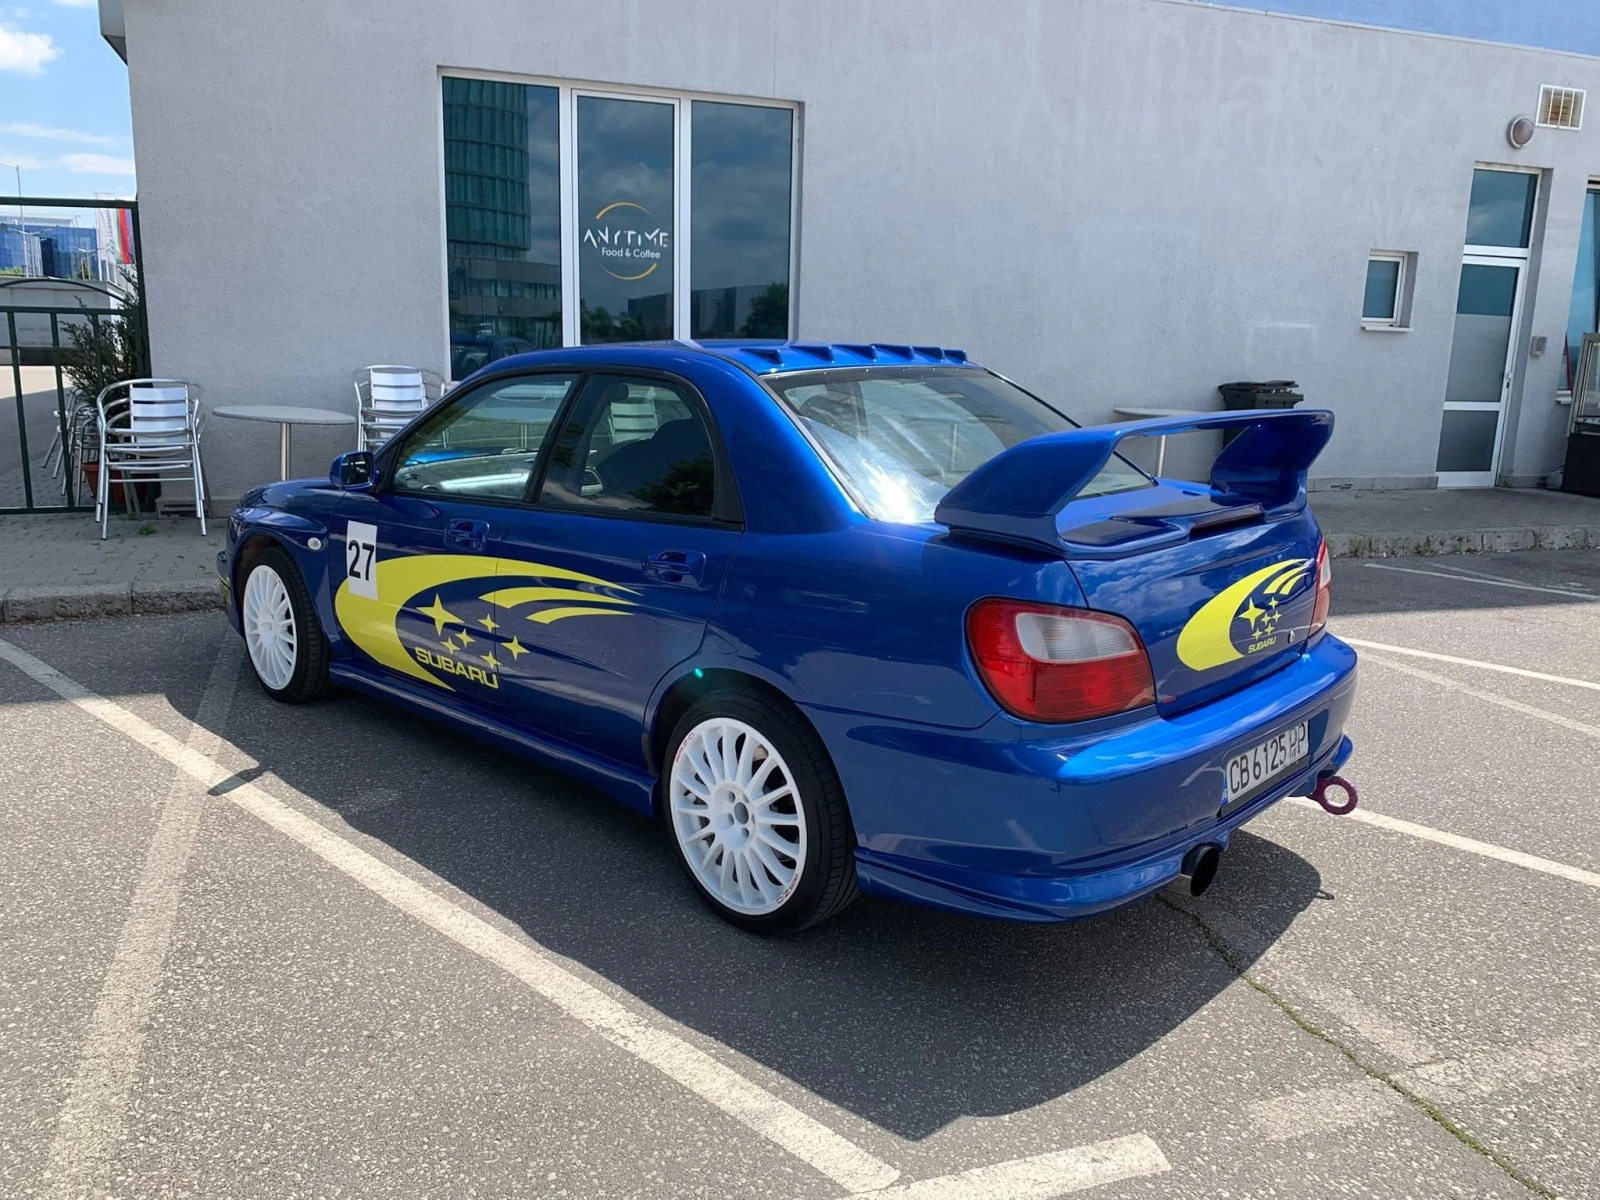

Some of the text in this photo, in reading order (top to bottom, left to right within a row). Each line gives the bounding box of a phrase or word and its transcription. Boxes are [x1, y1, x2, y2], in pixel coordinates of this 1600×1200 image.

[583, 225, 668, 249] ANYTIME
[602, 247, 661, 259] Food & Coffee
[348, 539, 375, 581] 27
[1248, 636, 1276, 653] SUBARU
[415, 647, 498, 689] SUBARU
[1229, 754, 1250, 794] CB
[1253, 734, 1287, 780] 6125
